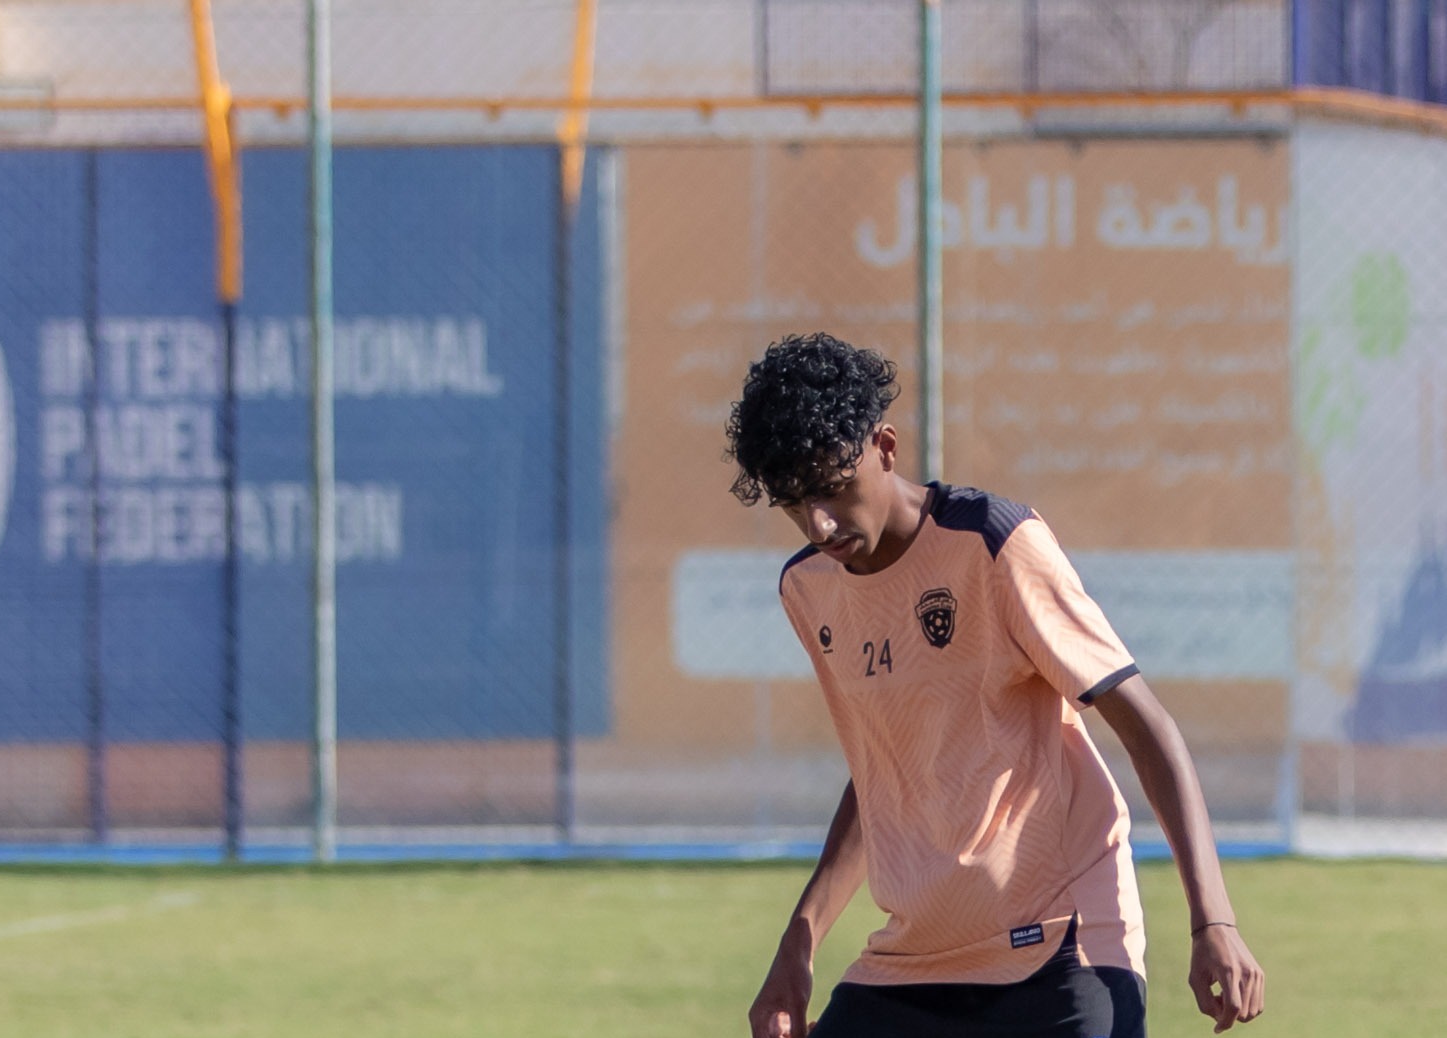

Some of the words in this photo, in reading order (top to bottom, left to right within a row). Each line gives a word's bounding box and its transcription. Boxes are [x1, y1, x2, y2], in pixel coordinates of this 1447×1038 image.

[42, 402, 229, 479] PADEL
[43, 484, 403, 562] FEDERATON
[863, 638, 893, 677] 24
